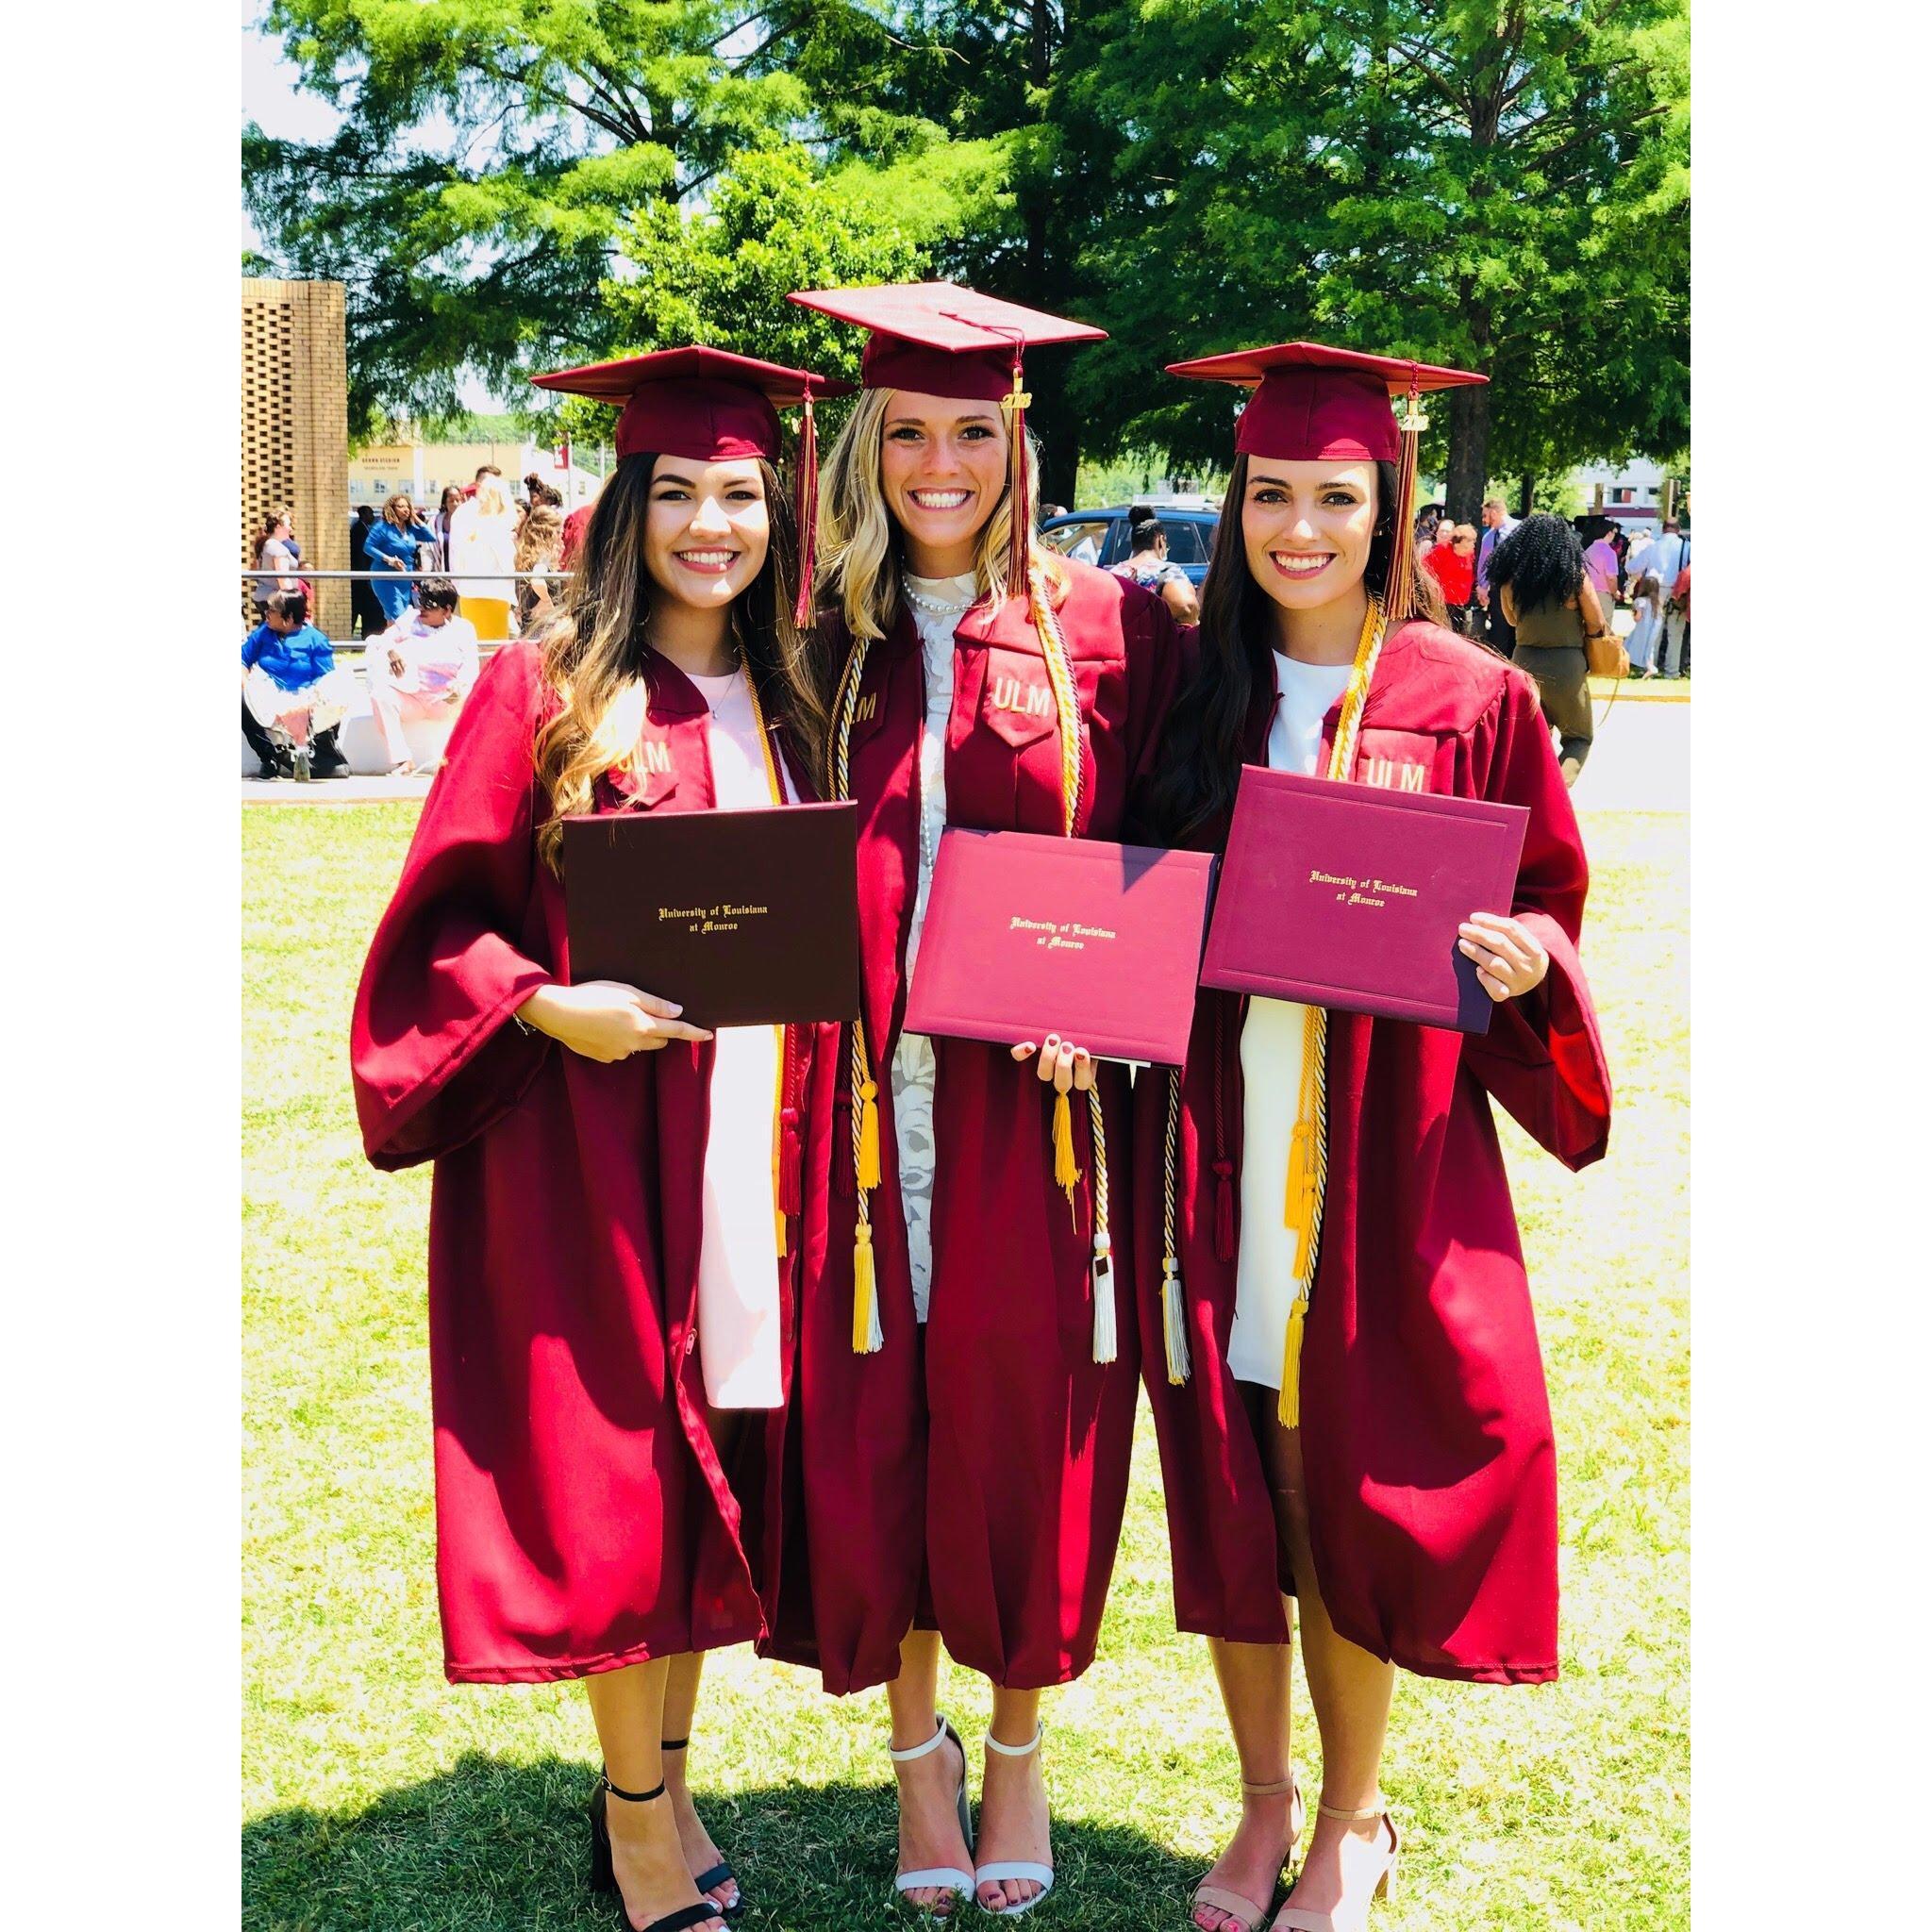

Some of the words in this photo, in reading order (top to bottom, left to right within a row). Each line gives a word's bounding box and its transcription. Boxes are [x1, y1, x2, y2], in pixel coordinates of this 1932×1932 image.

[993, 676, 1051, 718] ULM
[1309, 870, 1357, 890] University
[1360, 879, 1371, 889] of
[1373, 879, 1418, 897] Louisiana
[1336, 891, 1346, 901] at
[1347, 892, 1385, 907] Monroe
[658, 908, 707, 921] University
[710, 906, 720, 916] of
[723, 905, 768, 918] Louisiana
[690, 924, 698, 932] at
[701, 921, 739, 934] Monroe
[1010, 916, 1058, 934] University
[1060, 924, 1070, 932] of
[1072, 924, 1116, 939] Louisiana
[1037, 936, 1046, 944] at
[1047, 936, 1085, 949] Monroe
